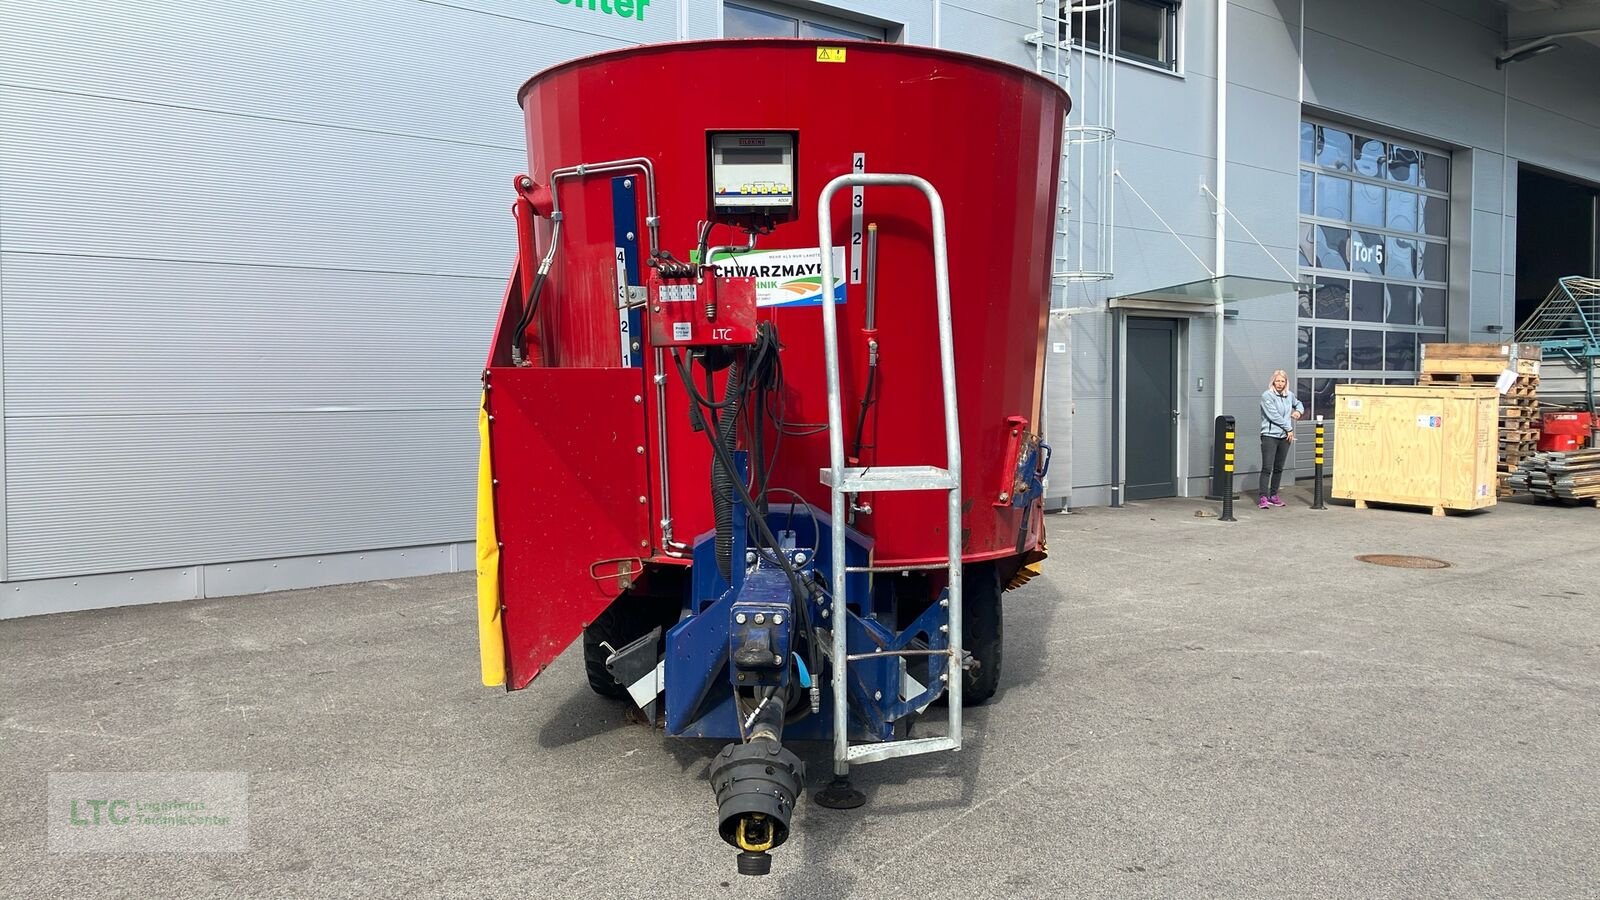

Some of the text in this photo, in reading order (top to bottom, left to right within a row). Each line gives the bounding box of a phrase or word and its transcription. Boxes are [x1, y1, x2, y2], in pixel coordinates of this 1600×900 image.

[555, 0, 650, 21] ter
[855, 158, 863, 170] 4
[853, 195, 862, 207] 3
[853, 233, 861, 245] 2
[617, 251, 624, 263] 4
[1353, 241, 1383, 264] Tor 5
[714, 263, 822, 278] CHWARZMAY
[852, 268, 859, 280] 1
[621, 321, 628, 332] 2
[713, 328, 733, 341] LTC
[623, 354, 629, 366] 1
